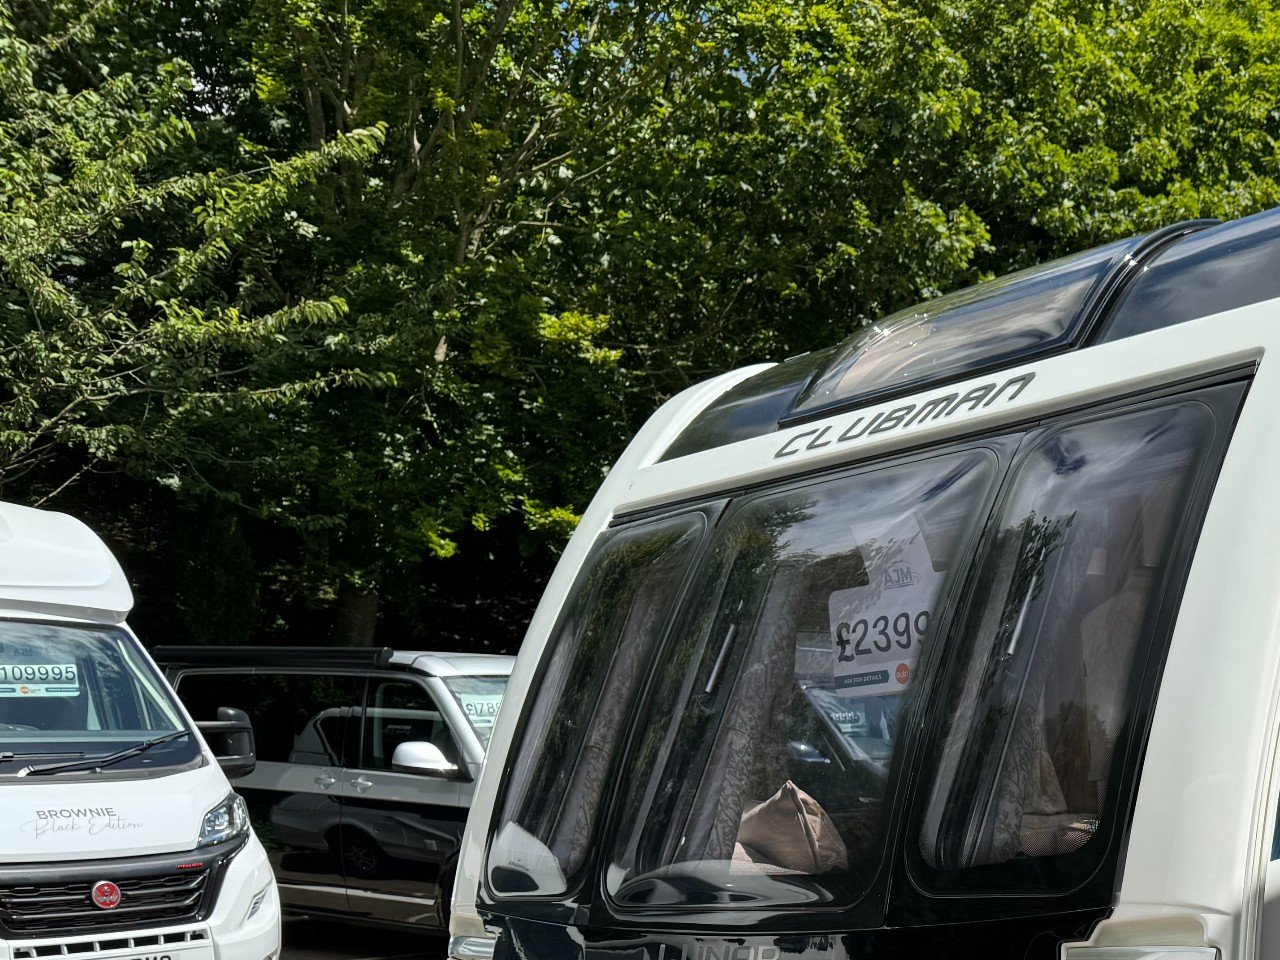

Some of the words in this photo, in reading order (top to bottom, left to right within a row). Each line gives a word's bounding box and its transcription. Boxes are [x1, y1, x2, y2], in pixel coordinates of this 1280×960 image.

[775, 371, 1036, 459] CLUBMAN
[863, 674, 882, 683] DETAILS
[35, 807, 117, 820] BROWNIE
[20, 817, 82, 839] Black
[88, 815, 143, 836] Edition
